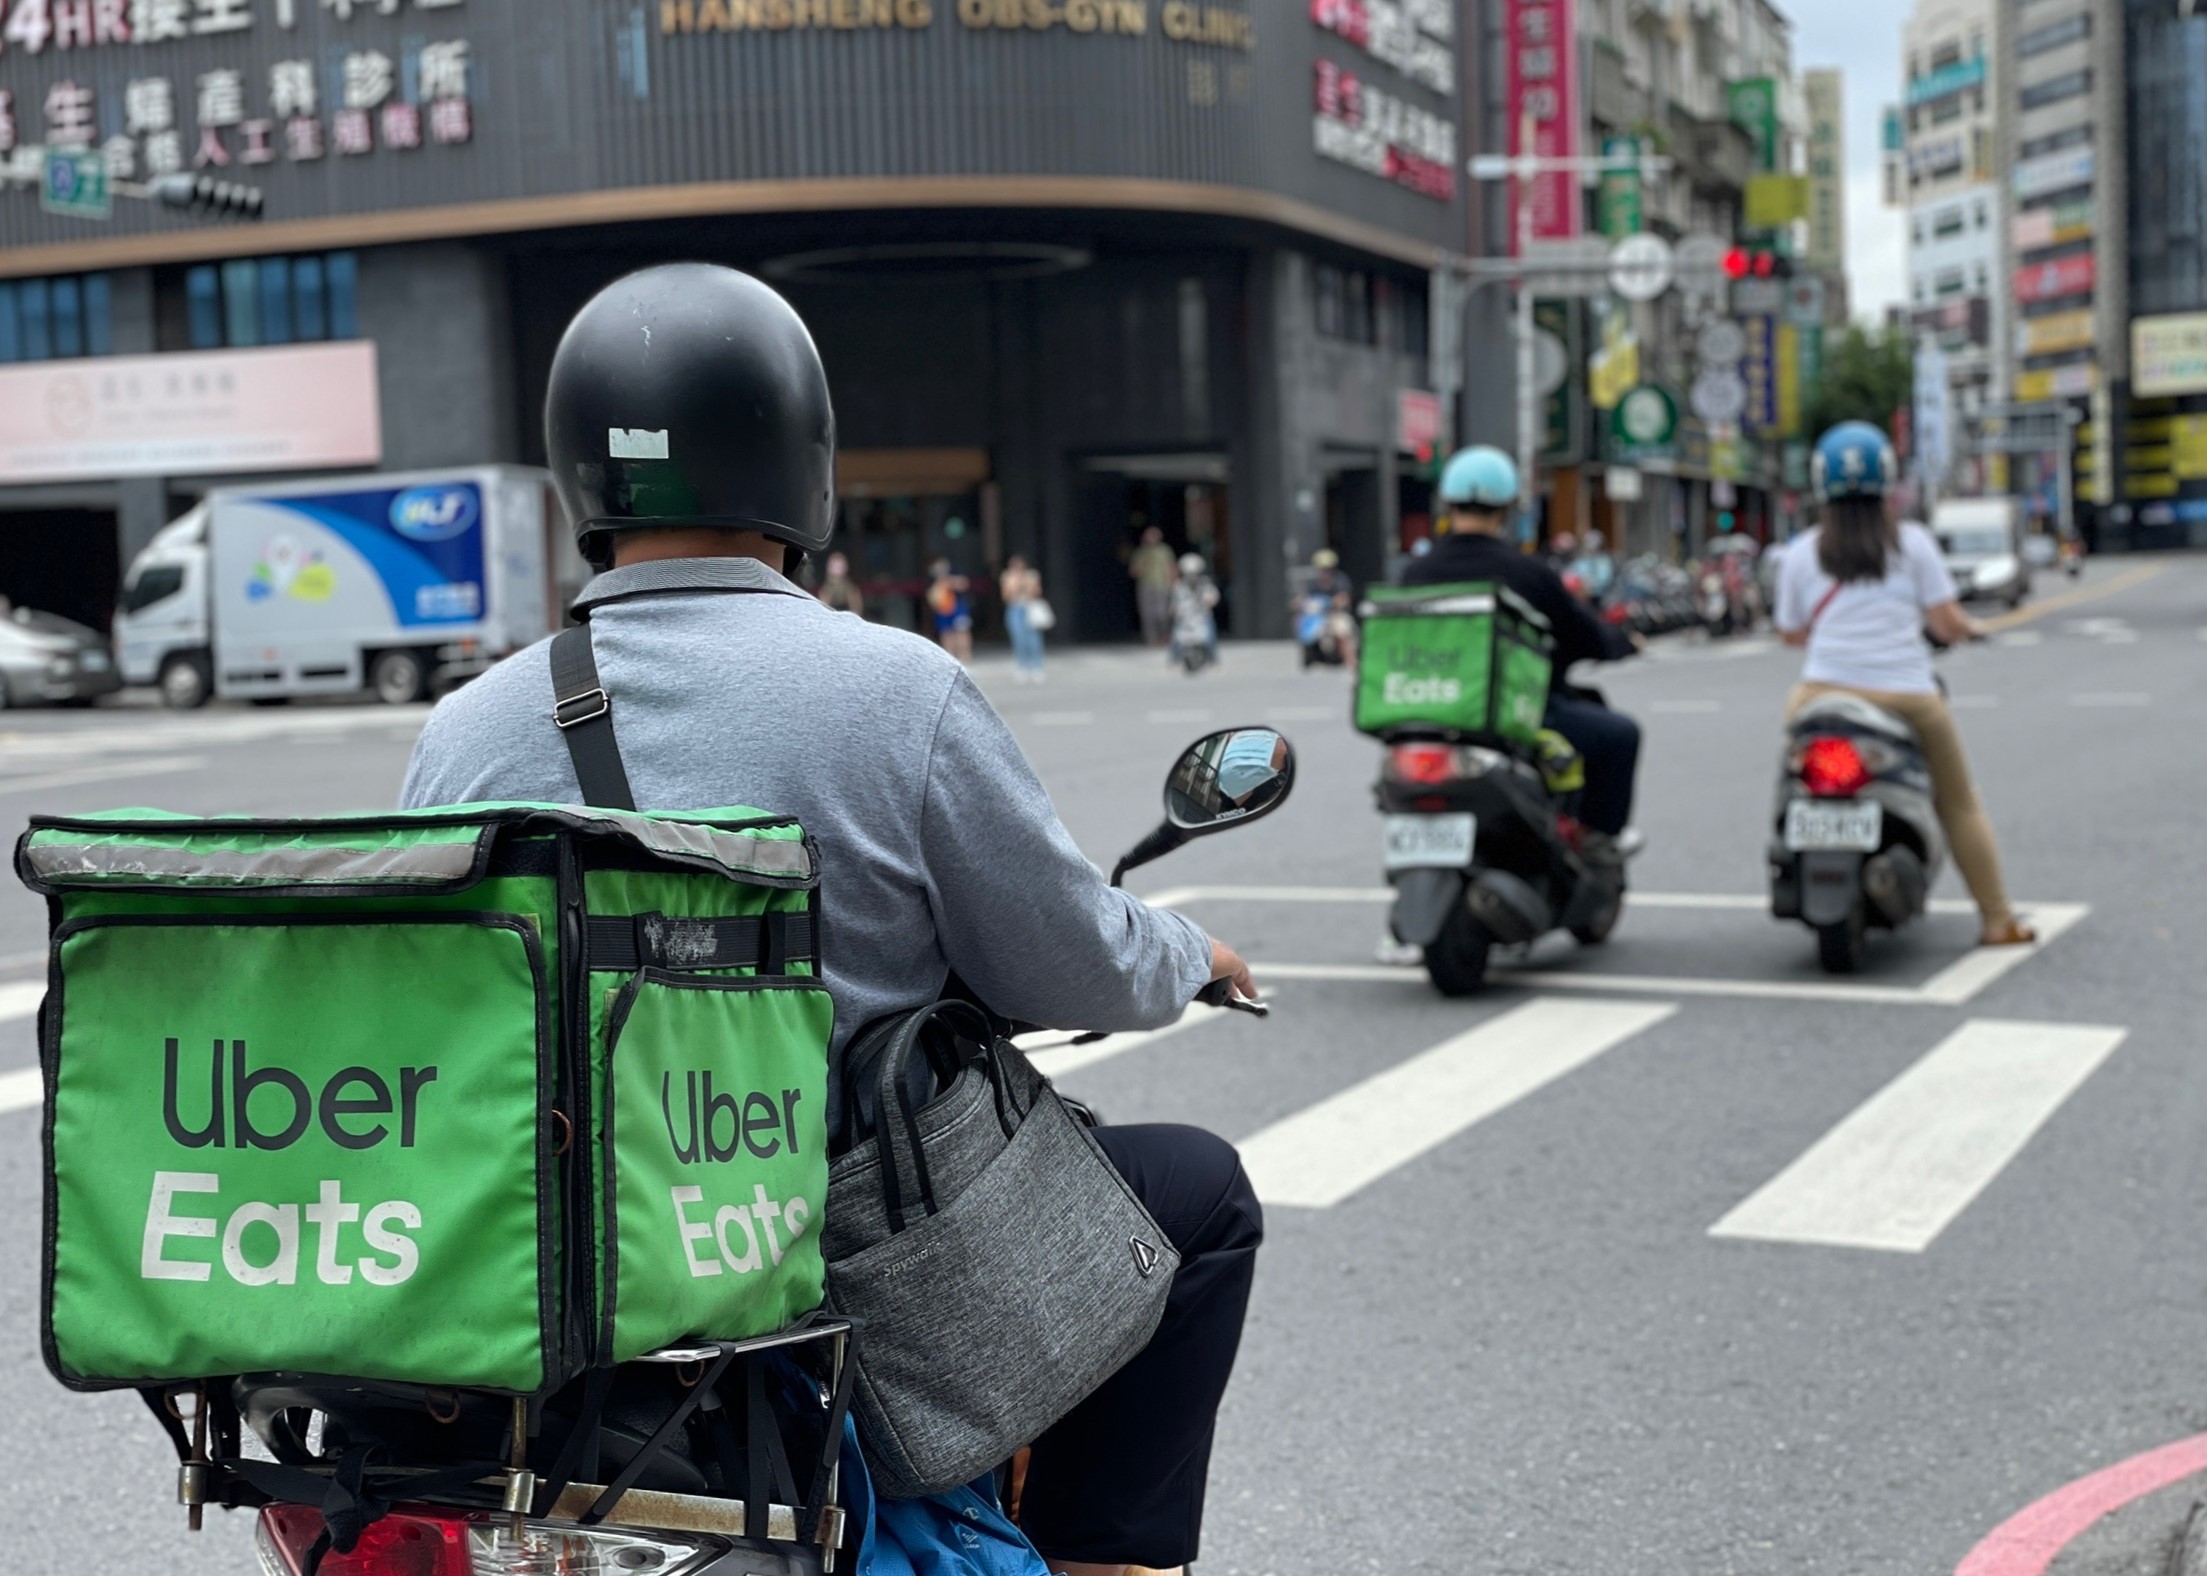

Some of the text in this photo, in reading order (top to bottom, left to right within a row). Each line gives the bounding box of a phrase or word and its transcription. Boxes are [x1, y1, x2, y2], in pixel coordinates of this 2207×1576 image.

[661, 0, 932, 34] HANSHENG
[957, 0, 1148, 35] OBS-GYN
[1384, 671, 1461, 704] Eats
[163, 1037, 438, 1150] Uber
[662, 1069, 802, 1165] Uber
[141, 1170, 422, 1286] Eats
[671, 1183, 809, 1278] Eats
